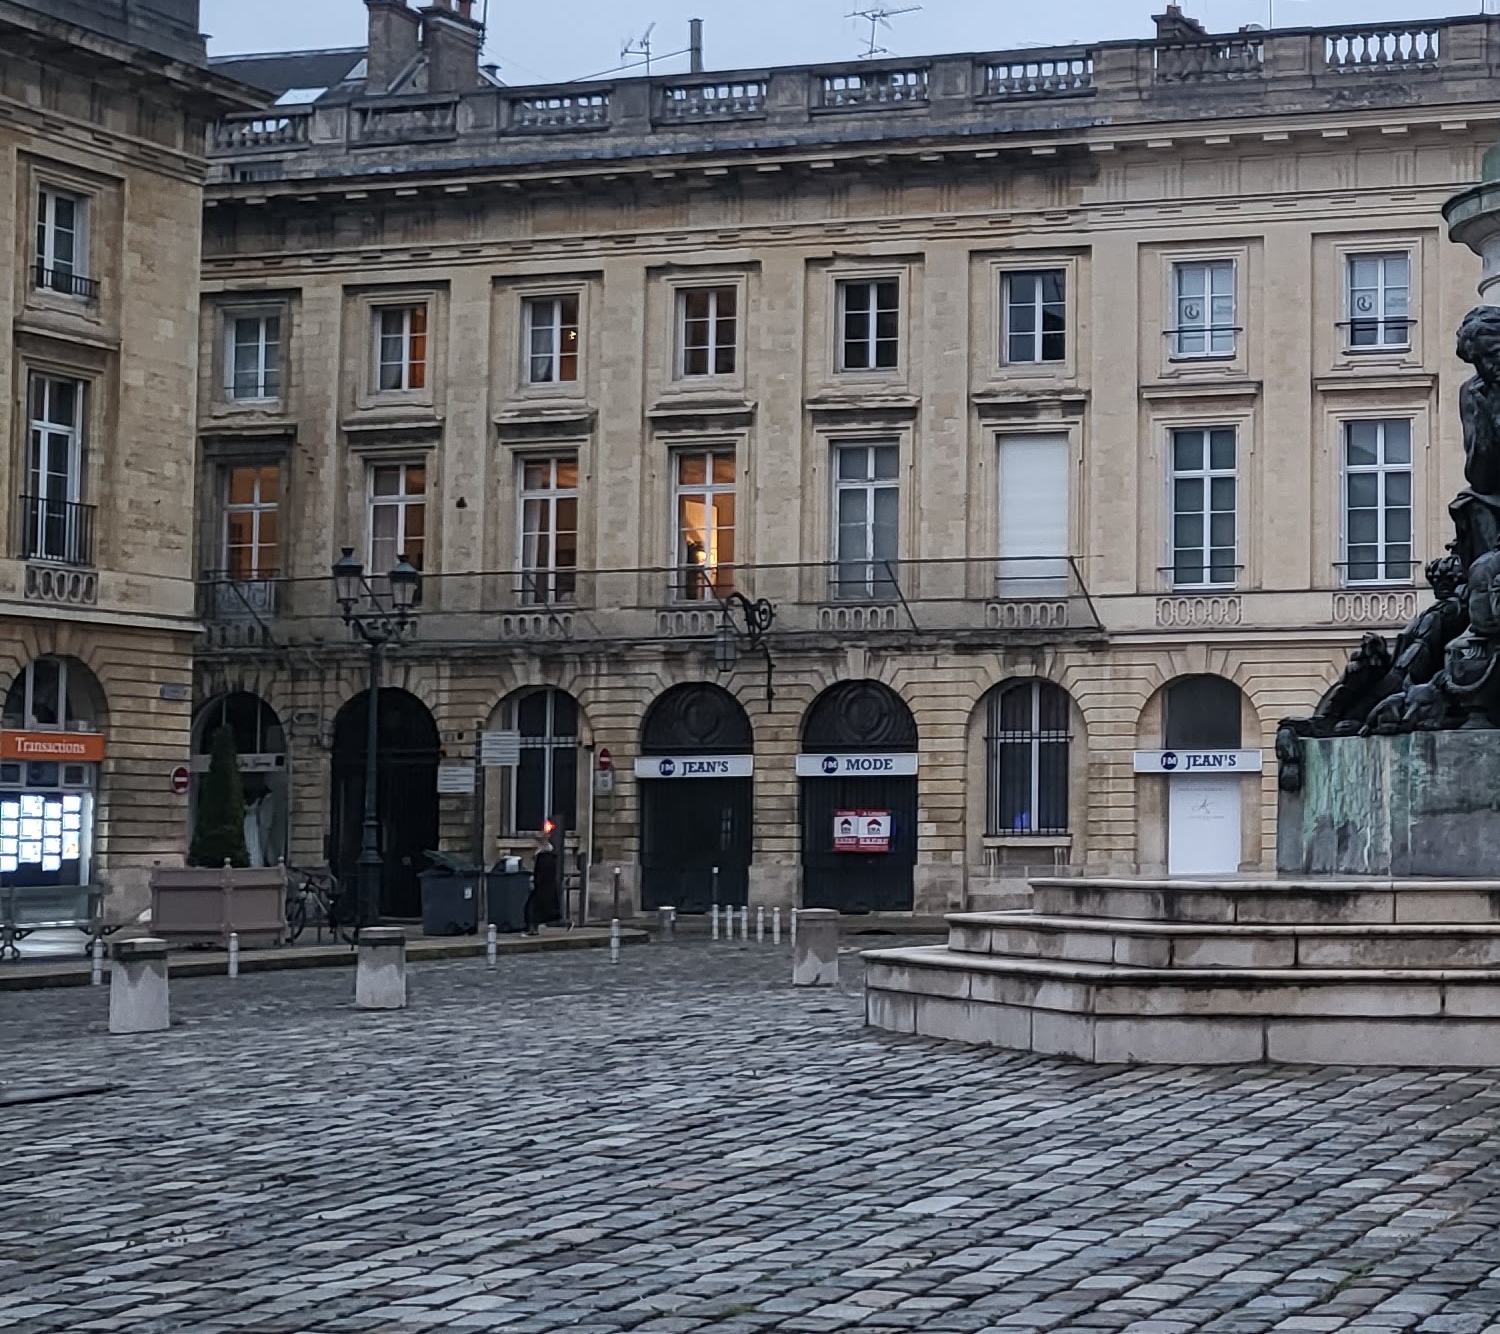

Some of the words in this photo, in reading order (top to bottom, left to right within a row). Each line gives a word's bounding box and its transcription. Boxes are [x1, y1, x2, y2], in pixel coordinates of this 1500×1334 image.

[15, 737, 86, 754] Transactions
[682, 761, 729, 776] JEAN'S
[846, 759, 893, 771] MODE
[1185, 755, 1236, 770] JEAN'S
